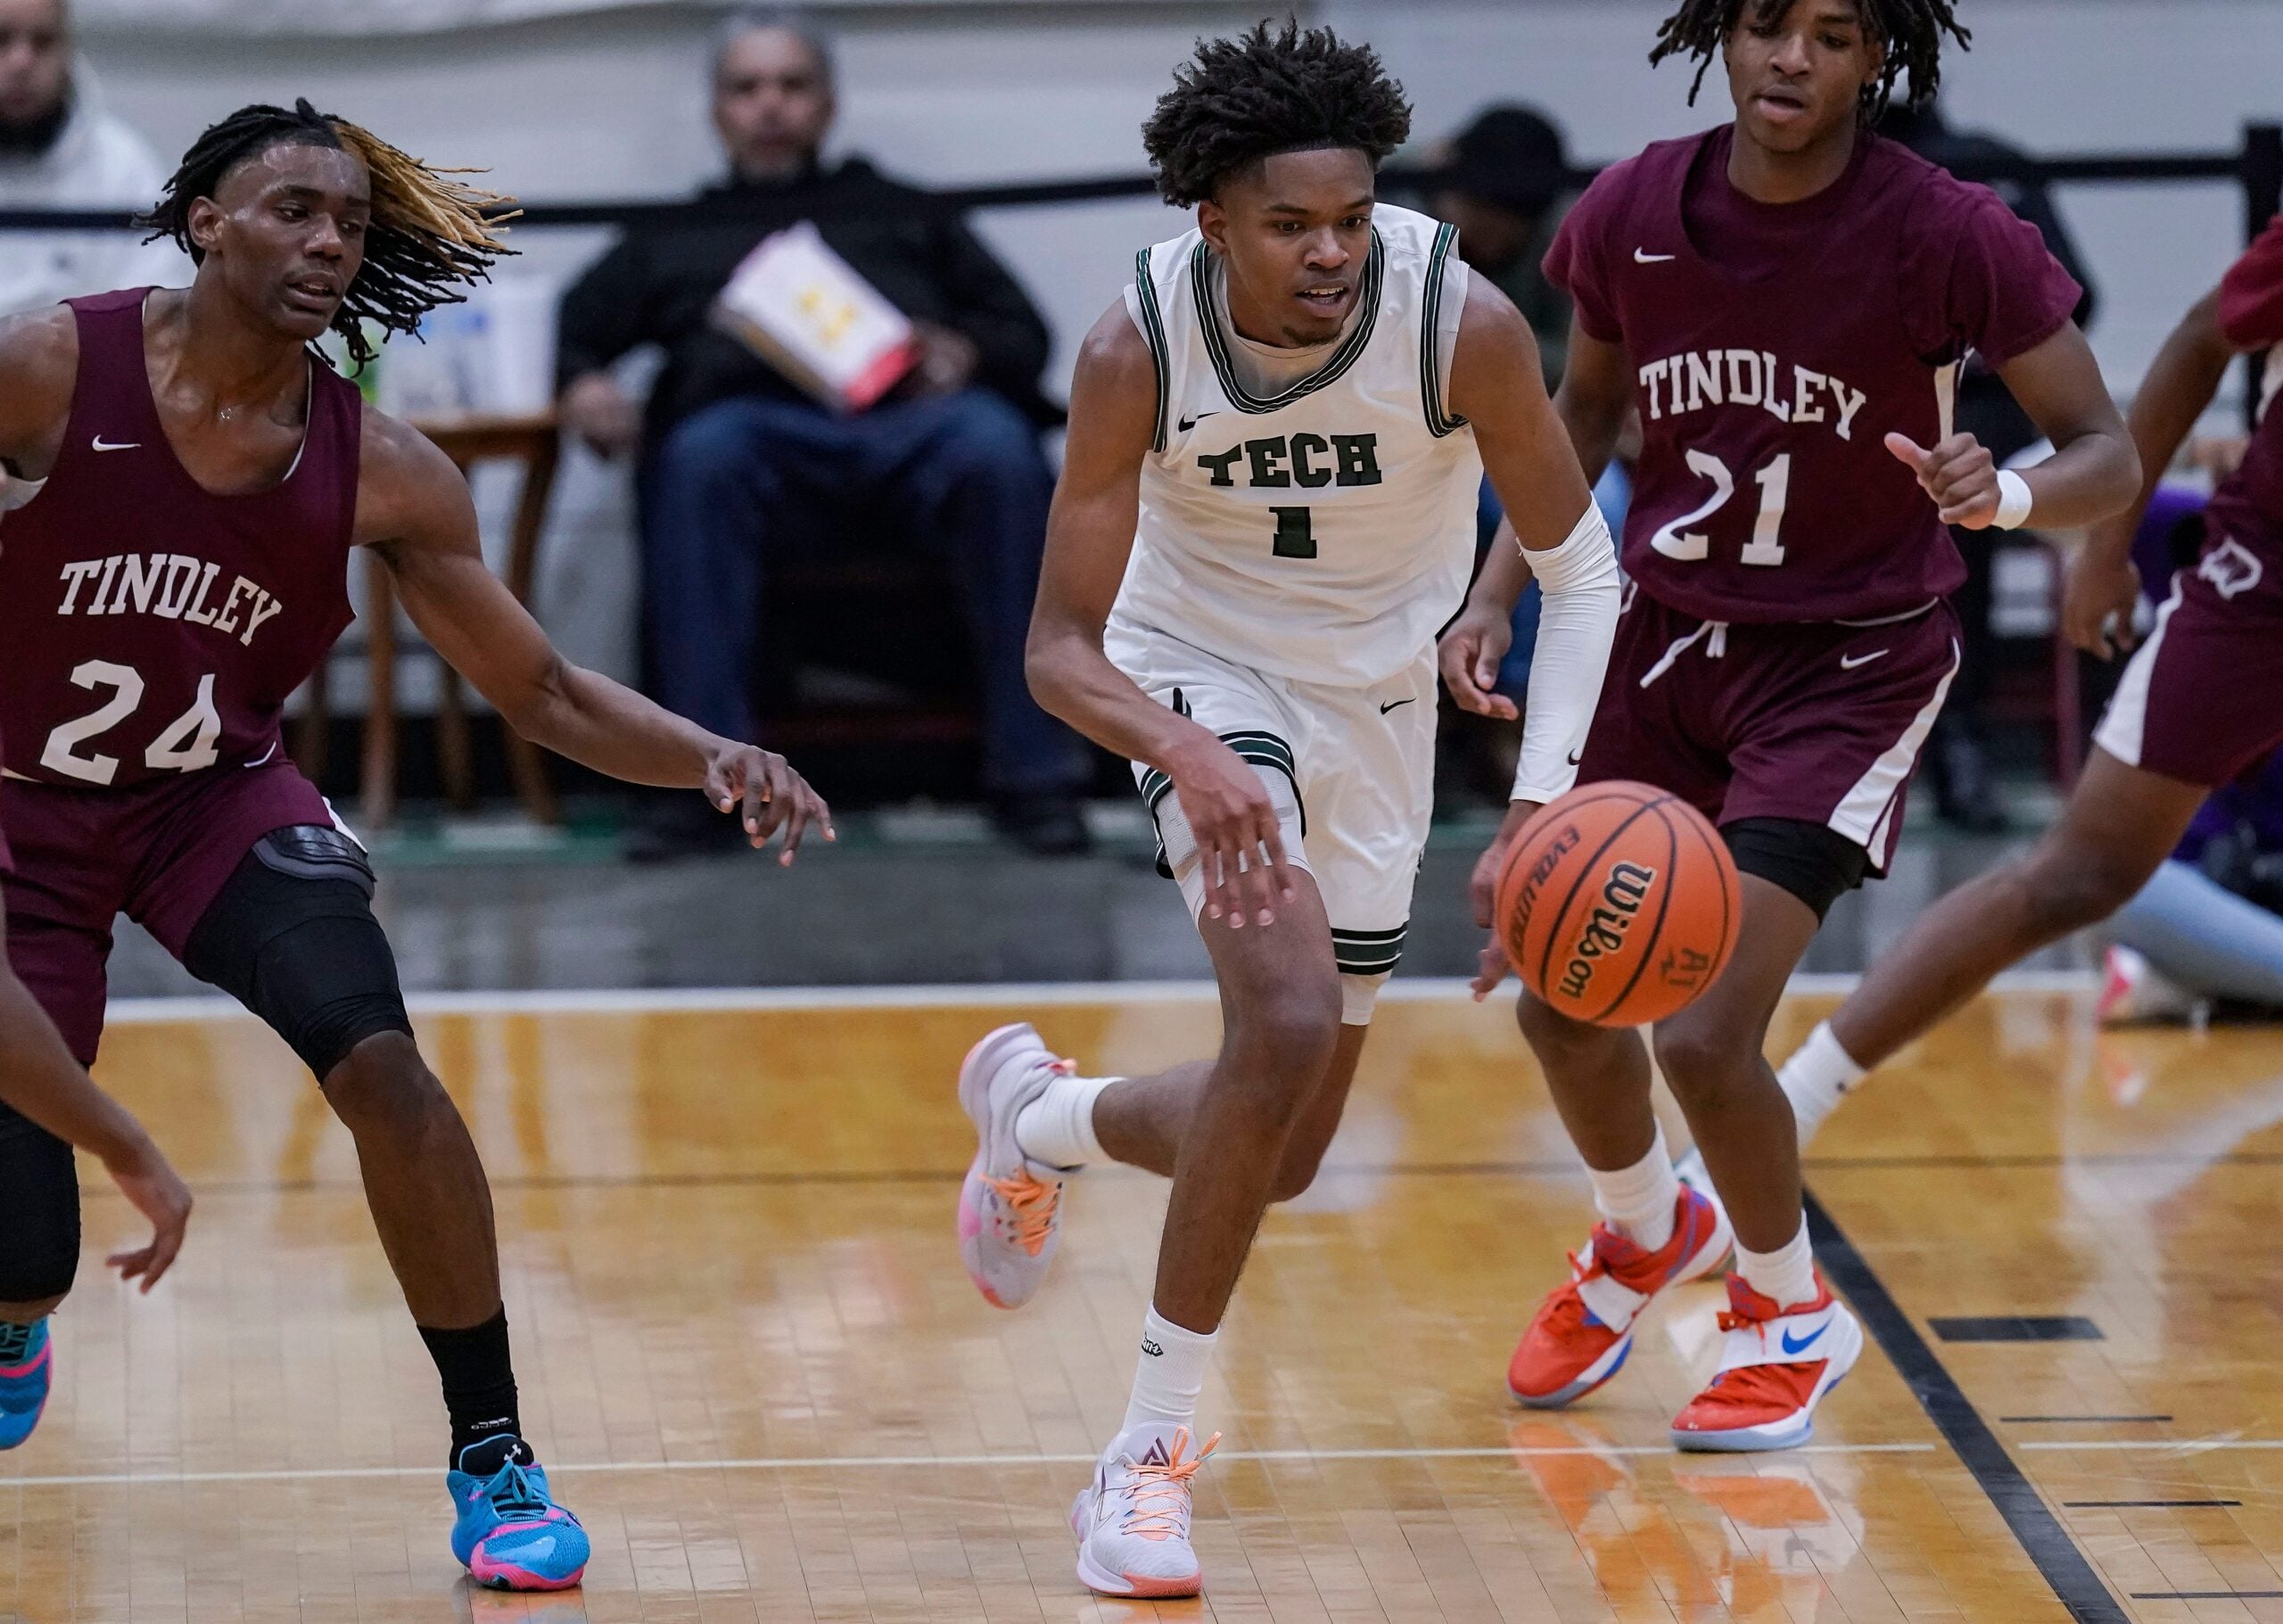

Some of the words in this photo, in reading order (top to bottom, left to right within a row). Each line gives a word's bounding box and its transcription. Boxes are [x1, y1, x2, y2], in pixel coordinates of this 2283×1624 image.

[1639, 349, 1867, 441] TINDLEY
[1198, 433, 1382, 488] TECH
[1651, 449, 1791, 565] 21
[1269, 507, 1317, 558] 1
[58, 553, 283, 647] TINDLEY
[40, 659, 221, 786] 24
[1558, 861, 1655, 999] Wilson
